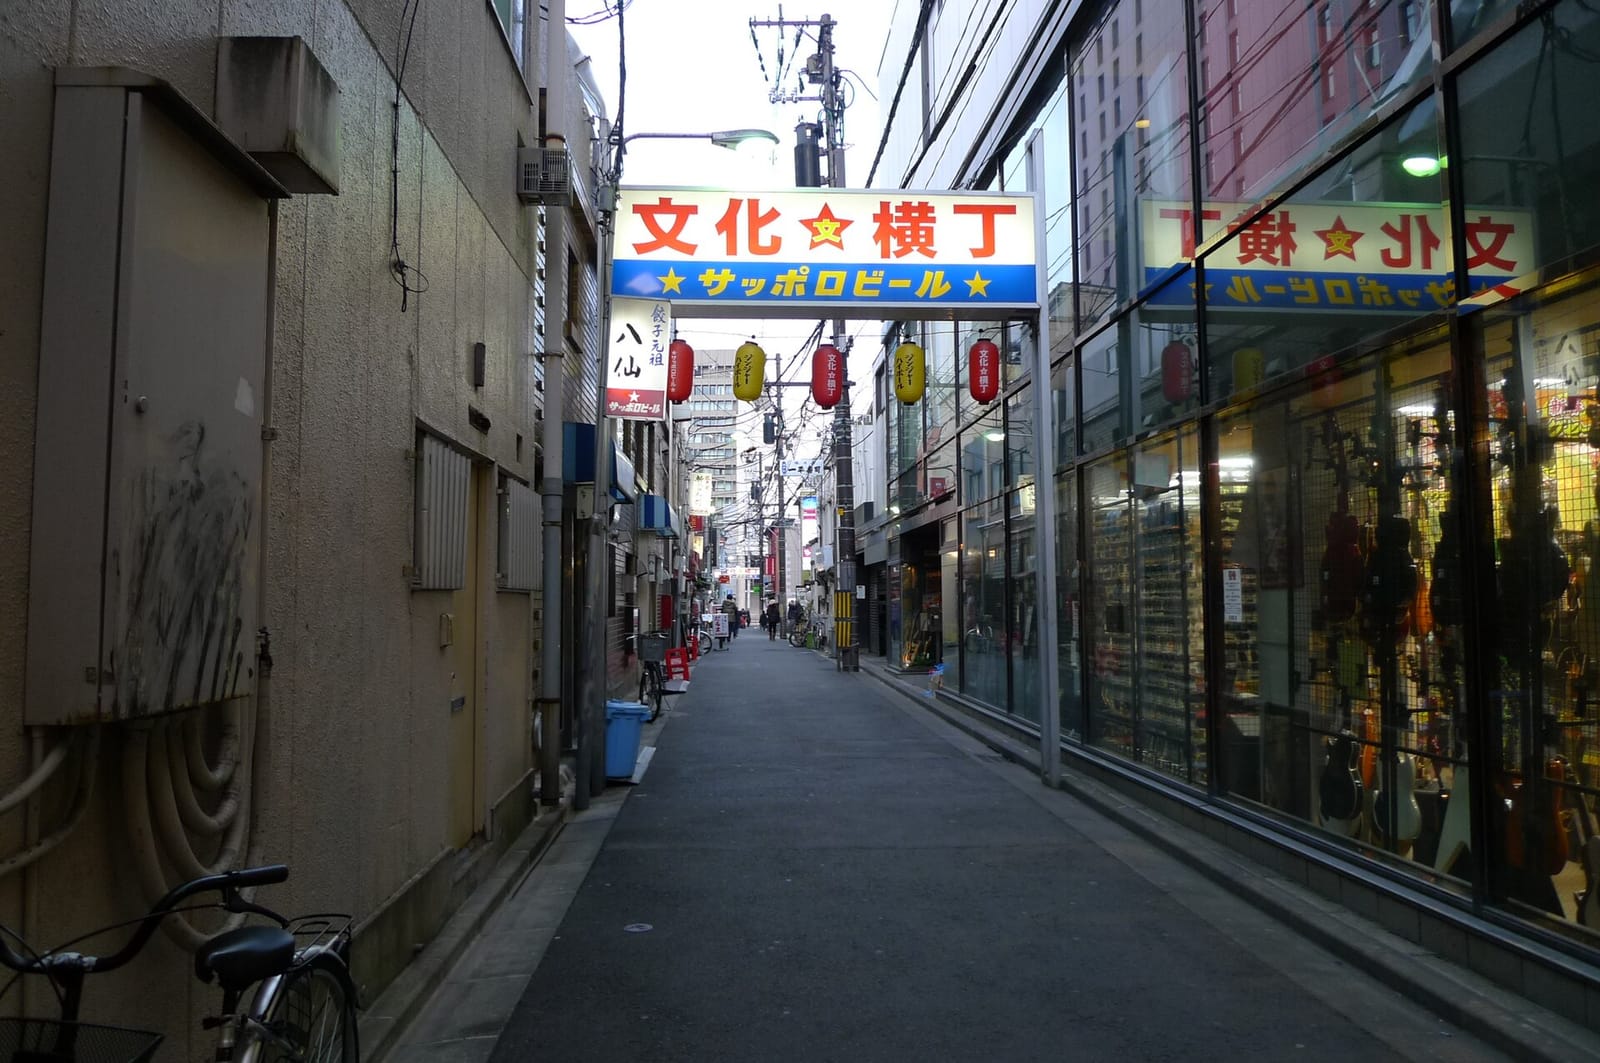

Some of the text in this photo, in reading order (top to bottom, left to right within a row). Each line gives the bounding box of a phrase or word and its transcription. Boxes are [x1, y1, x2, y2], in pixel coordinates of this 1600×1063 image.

[698, 265, 952, 298] サッポロビール
[614, 323, 642, 378] 八仙
[650, 304, 666, 366] 餃子元祖
[609, 401, 661, 414] サッポロビール
